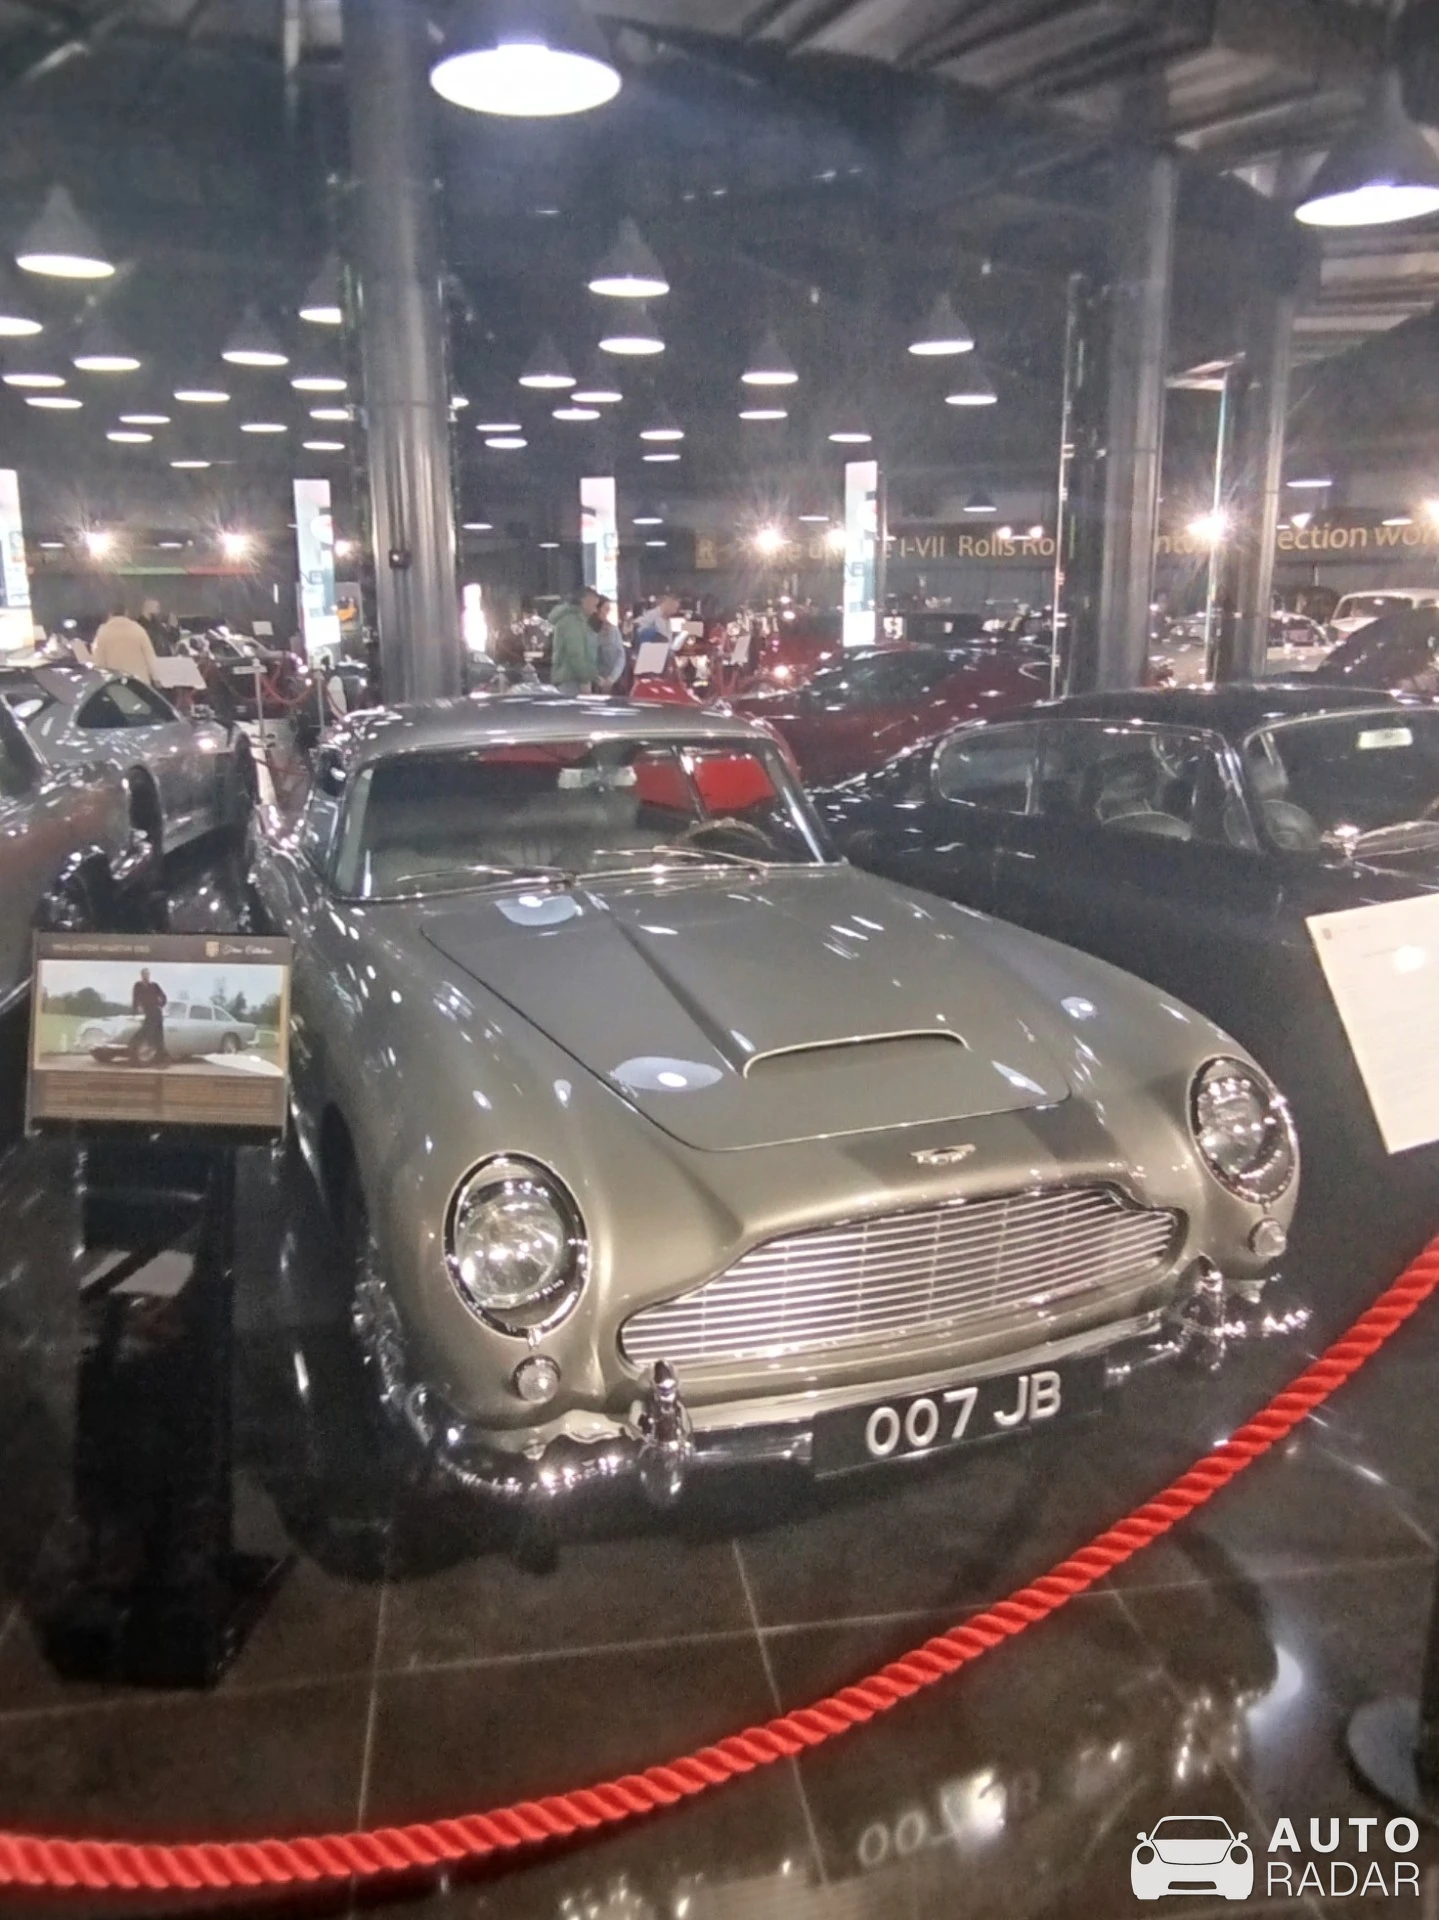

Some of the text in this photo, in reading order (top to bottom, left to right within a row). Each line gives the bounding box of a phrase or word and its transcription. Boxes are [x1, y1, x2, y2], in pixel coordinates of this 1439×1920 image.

[900, 536, 945, 559] I-VII
[958, 529, 1016, 558] Rolls
[865, 1370, 1062, 1456] 007 JB
